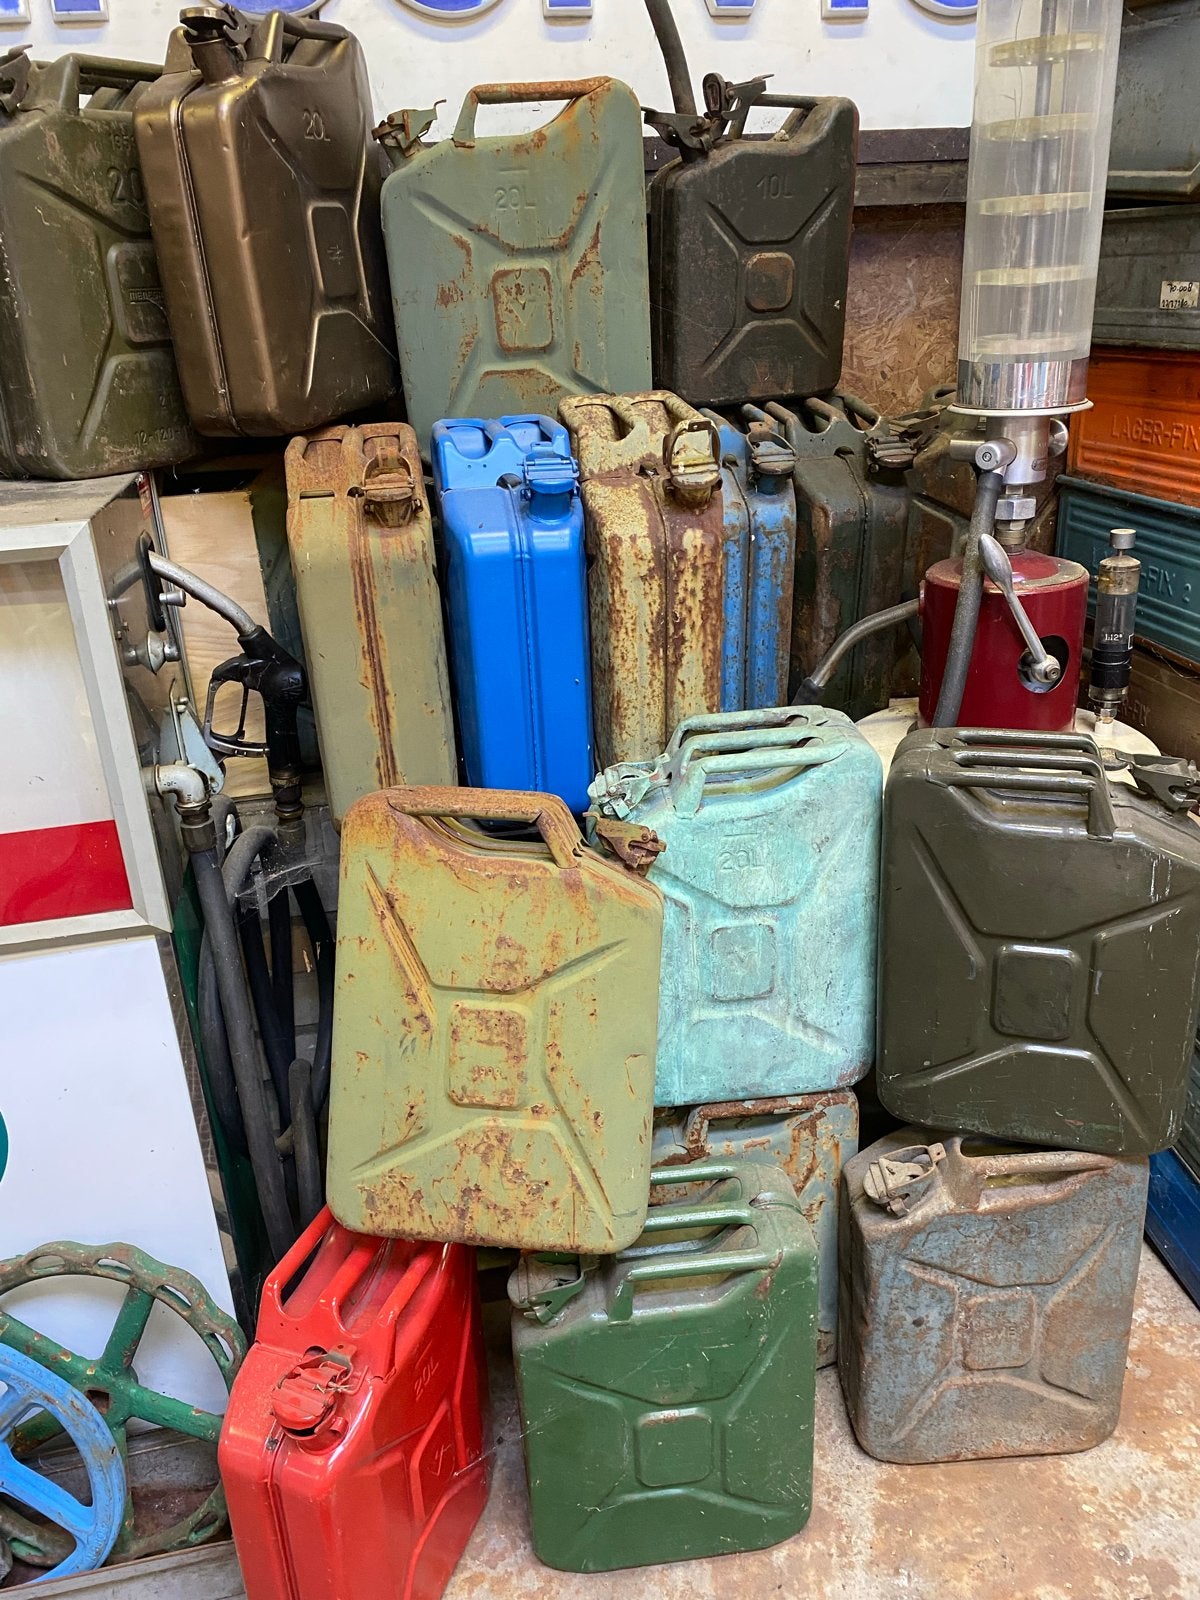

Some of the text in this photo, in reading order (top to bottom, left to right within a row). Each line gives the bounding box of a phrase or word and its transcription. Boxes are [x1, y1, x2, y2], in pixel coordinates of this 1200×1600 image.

[303, 109, 331, 141] 20L
[494, 186, 537, 211] 20L
[756, 174, 793, 200] 10L
[719, 849, 765, 871] 20L
[414, 1356, 440, 1402] 20L
